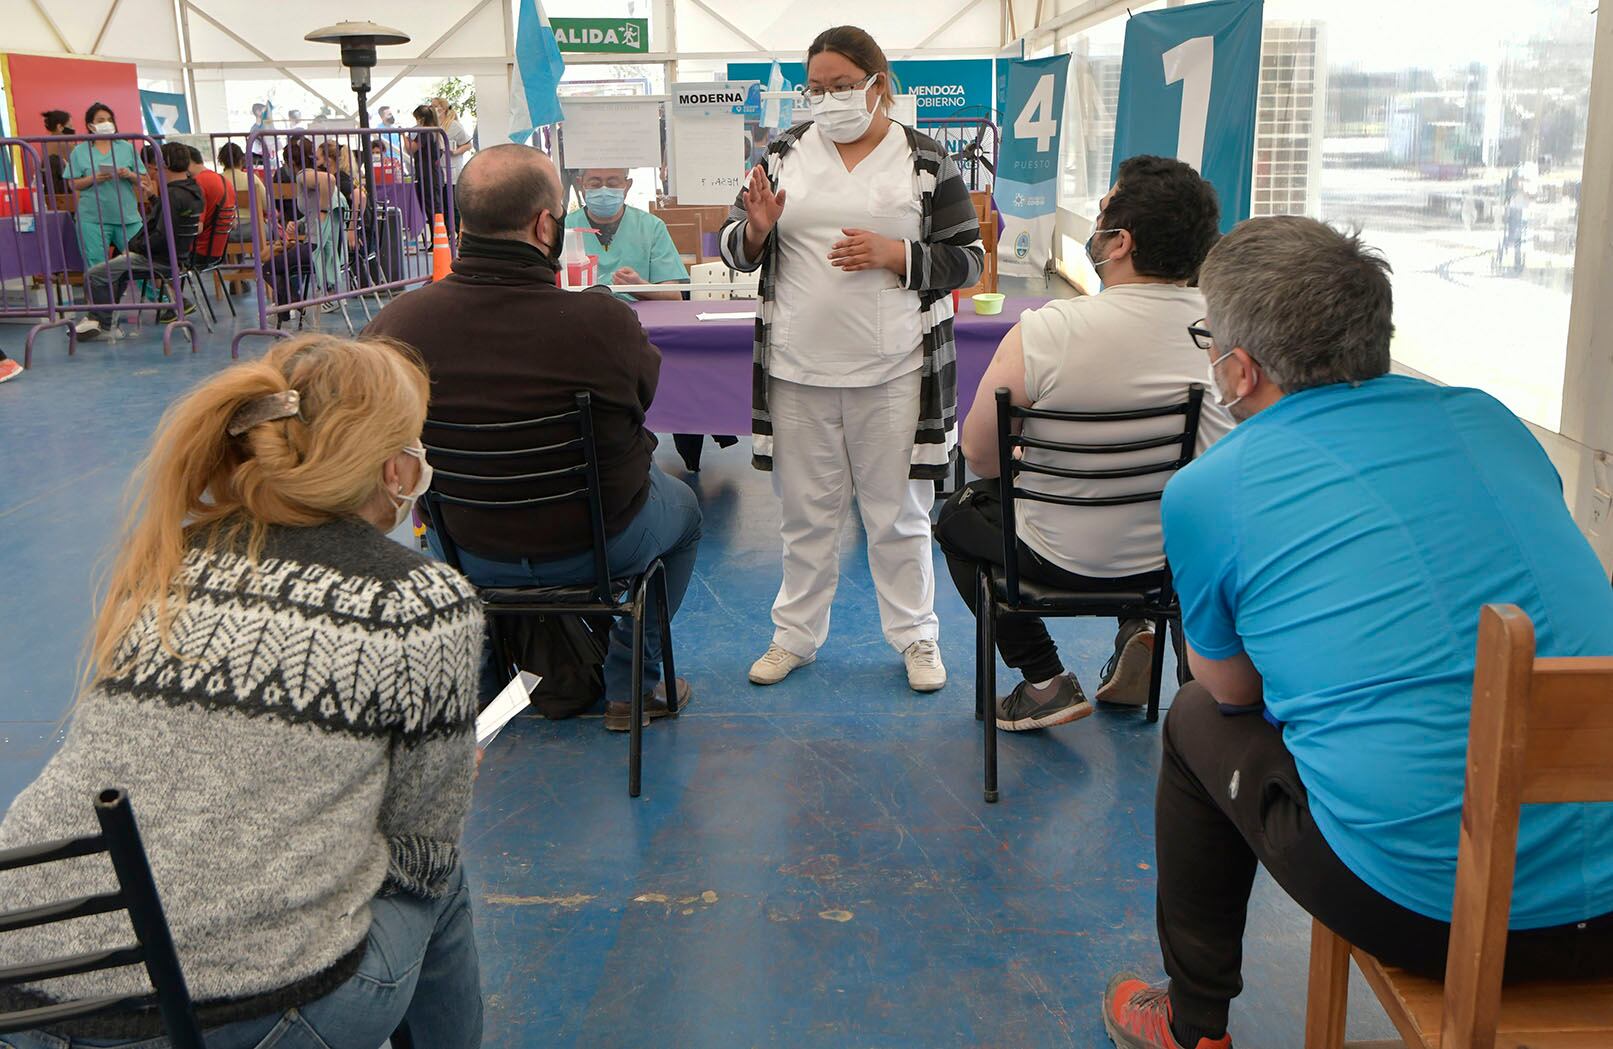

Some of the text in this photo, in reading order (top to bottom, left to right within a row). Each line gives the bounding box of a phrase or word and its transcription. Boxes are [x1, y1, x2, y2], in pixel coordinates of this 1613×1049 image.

[555, 28, 619, 44] ALIDA
[908, 85, 965, 96] MENDOZA
[679, 92, 743, 104] MODERNA
[916, 97, 966, 108] OBIERNO
[1162, 36, 1214, 176] 1
[1014, 74, 1057, 153] 4
[1014, 159, 1050, 169] PUESTO
